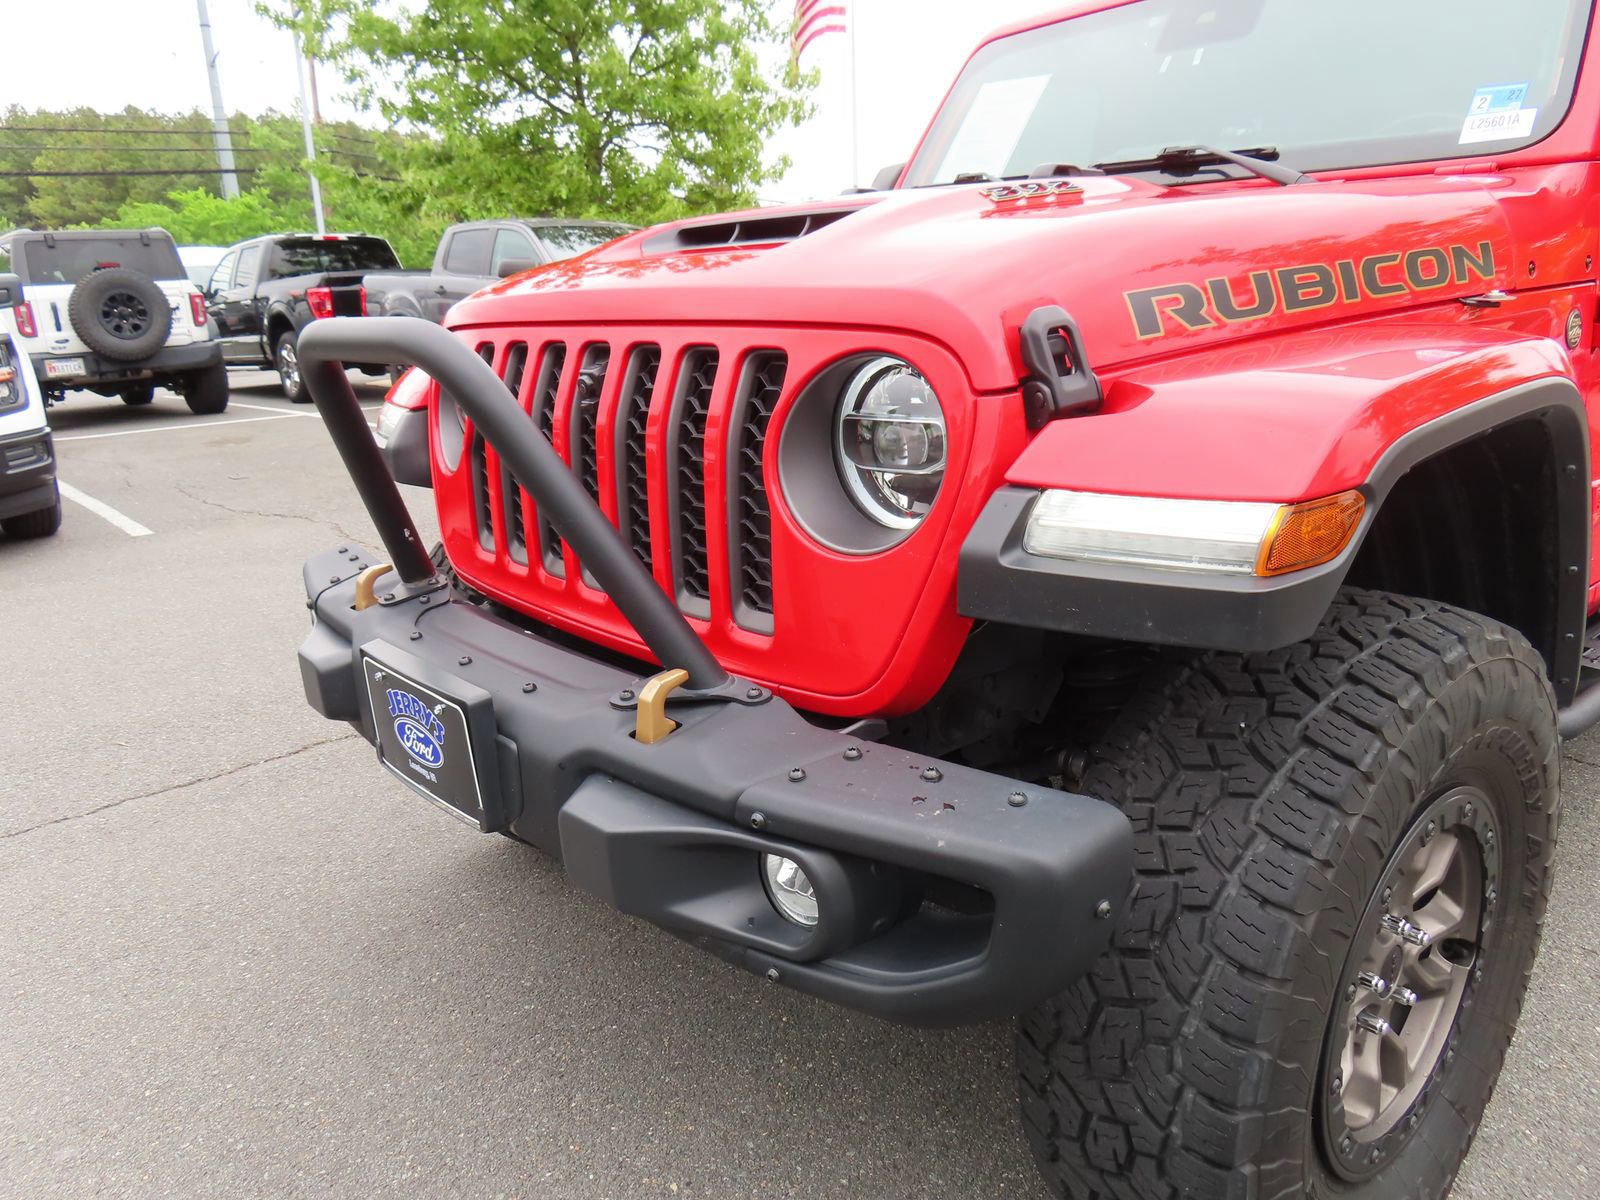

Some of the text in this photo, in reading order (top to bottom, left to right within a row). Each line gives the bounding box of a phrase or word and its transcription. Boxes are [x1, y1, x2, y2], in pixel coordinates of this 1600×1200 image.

[1478, 89, 1523, 109] 2 27
[978, 181, 1084, 203] 392
[1123, 240, 1496, 340] RUBICON
[387, 689, 445, 744] JERRY'S
[404, 725, 435, 761] Ford
